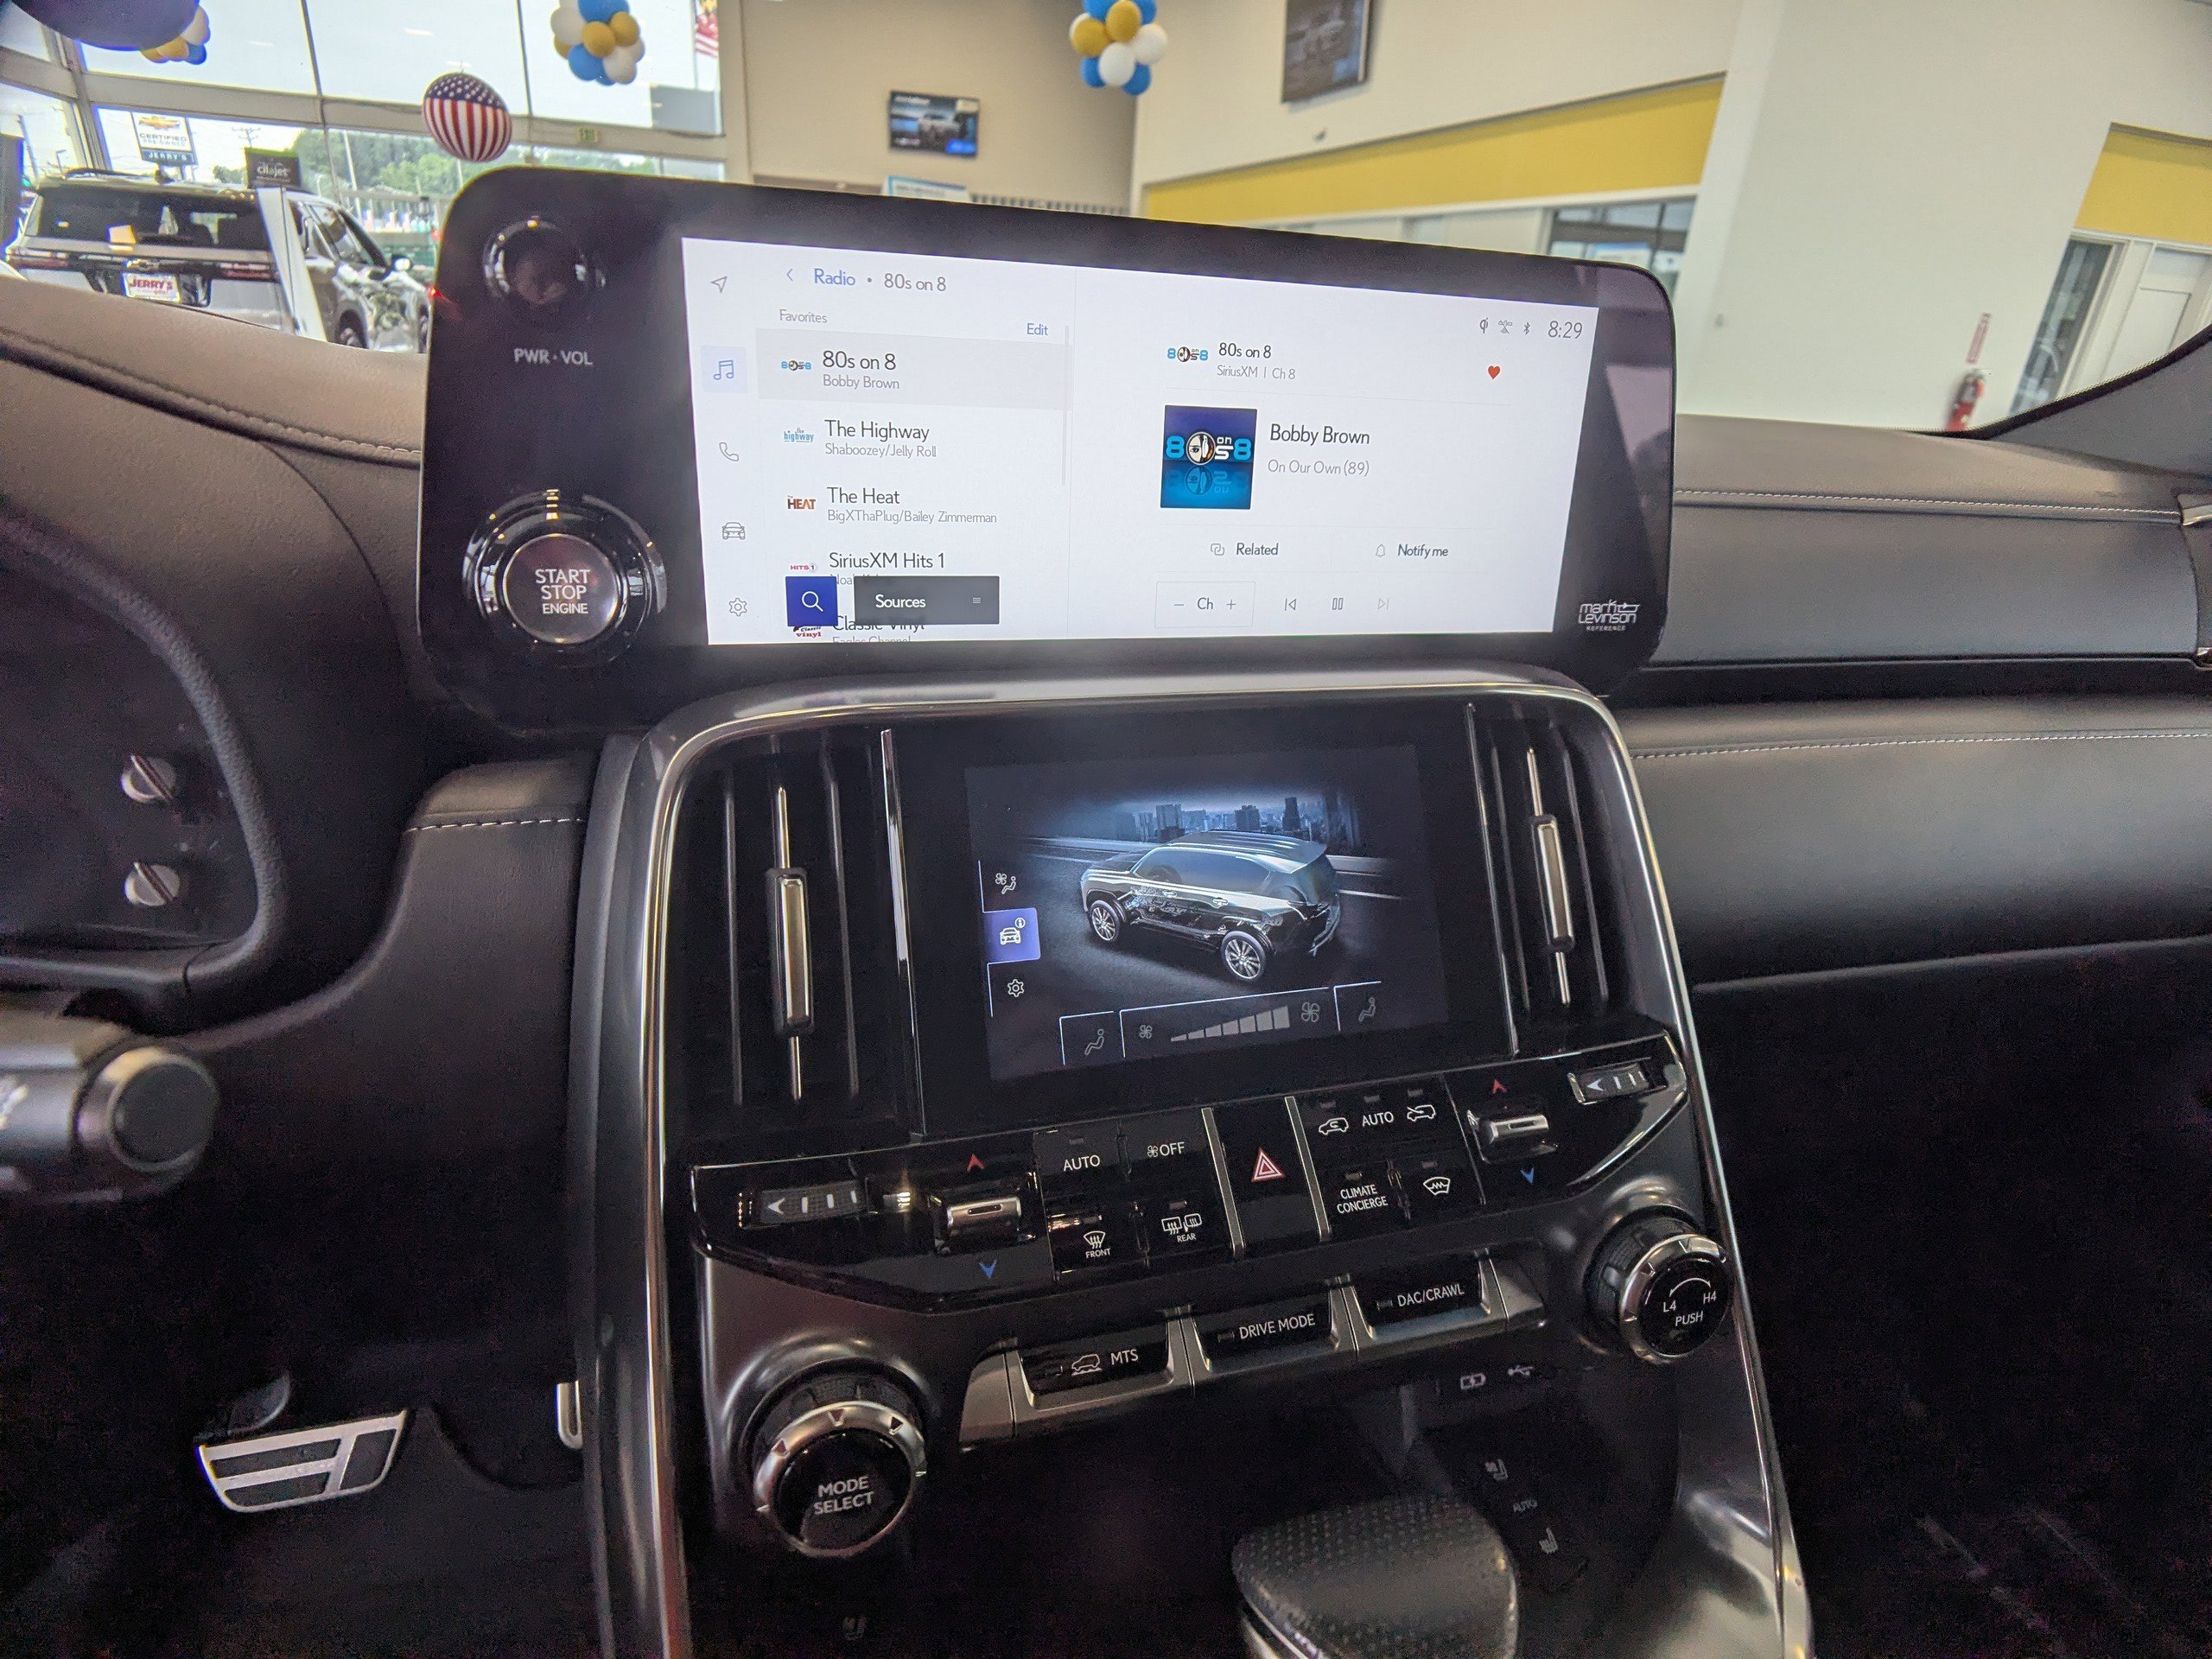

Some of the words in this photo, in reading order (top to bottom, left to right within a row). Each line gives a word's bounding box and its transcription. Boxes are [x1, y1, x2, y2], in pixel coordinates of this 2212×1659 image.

[814, 268, 855, 286] Radio
[884, 273, 912, 289] 80s
[916, 281, 933, 291] on
[937, 276, 947, 292] 8
[779, 309, 828, 324] Favorites
[1027, 322, 1049, 336] Edit
[1548, 320, 1583, 339] 8:29
[513, 347, 550, 364] PWR
[561, 349, 594, 365] VOL
[1218, 342, 1242, 357] 80s
[1245, 348, 1260, 358] on
[1262, 345, 1271, 359] 8
[823, 350, 855, 369] 80s
[860, 358, 880, 370] on
[884, 353, 896, 371] 8
[1217, 364, 1258, 378] SiriusXM
[1272, 367, 1286, 379] Ch
[1288, 368, 1296, 379] 8
[823, 373, 860, 390] Bobby
[863, 375, 900, 389] Brown
[784, 430, 814, 442] highway
[824, 419, 855, 436] The
[861, 421, 930, 442] Highway
[1270, 423, 1319, 446] Bobby
[1322, 426, 1370, 444] Brown
[825, 442, 913, 458] Shaboozey/Jelly
[917, 445, 937, 457] Roll
[1268, 460, 1286, 474] On
[1289, 460, 1312, 474] Our
[1313, 461, 1340, 474] Own
[1344, 460, 1370, 477] (89)
[827, 486, 857, 504] The
[862, 487, 900, 505] Heat
[787, 499, 816, 509] HEAT
[828, 509, 934, 524] BigXThaPlug/Bailey
[938, 511, 997, 523] Zimmerman
[1236, 542, 1279, 556] Related
[1397, 543, 1431, 559] Notify
[1432, 547, 1449, 556] me
[829, 551, 898, 569] SiriusXM
[903, 552, 933, 569] Hits
[938, 552, 945, 569] 1
[535, 569, 591, 585] START
[541, 585, 588, 601] STOP
[874, 594, 926, 608] Sources
[542, 602, 588, 614] ENGINE
[1197, 597, 1214, 610] Ch
[1362, 1111, 1394, 1128] AUTO
[1159, 1141, 1185, 1156] OFF
[1063, 1154, 1101, 1172] AUTO
[1340, 1185, 1377, 1200] CLIMATE
[1337, 1196, 1389, 1215] CONCIERGE
[1177, 1233, 1197, 1243] REAR
[1085, 1248, 1111, 1259] FRONT
[1396, 1283, 1465, 1307] DAC/CRAWL
[1702, 1290, 1717, 1305] H4
[1662, 1300, 1677, 1313] L4
[1675, 1310, 1704, 1326] PUSH
[1238, 1319, 1276, 1340] DRIVE
[1278, 1313, 1316, 1335] MODE
[1110, 1349, 1139, 1366] MTS
[817, 1475, 869, 1497] MODE
[813, 1491, 875, 1515] SELECT
[1513, 1498, 1538, 1513] AUTO
